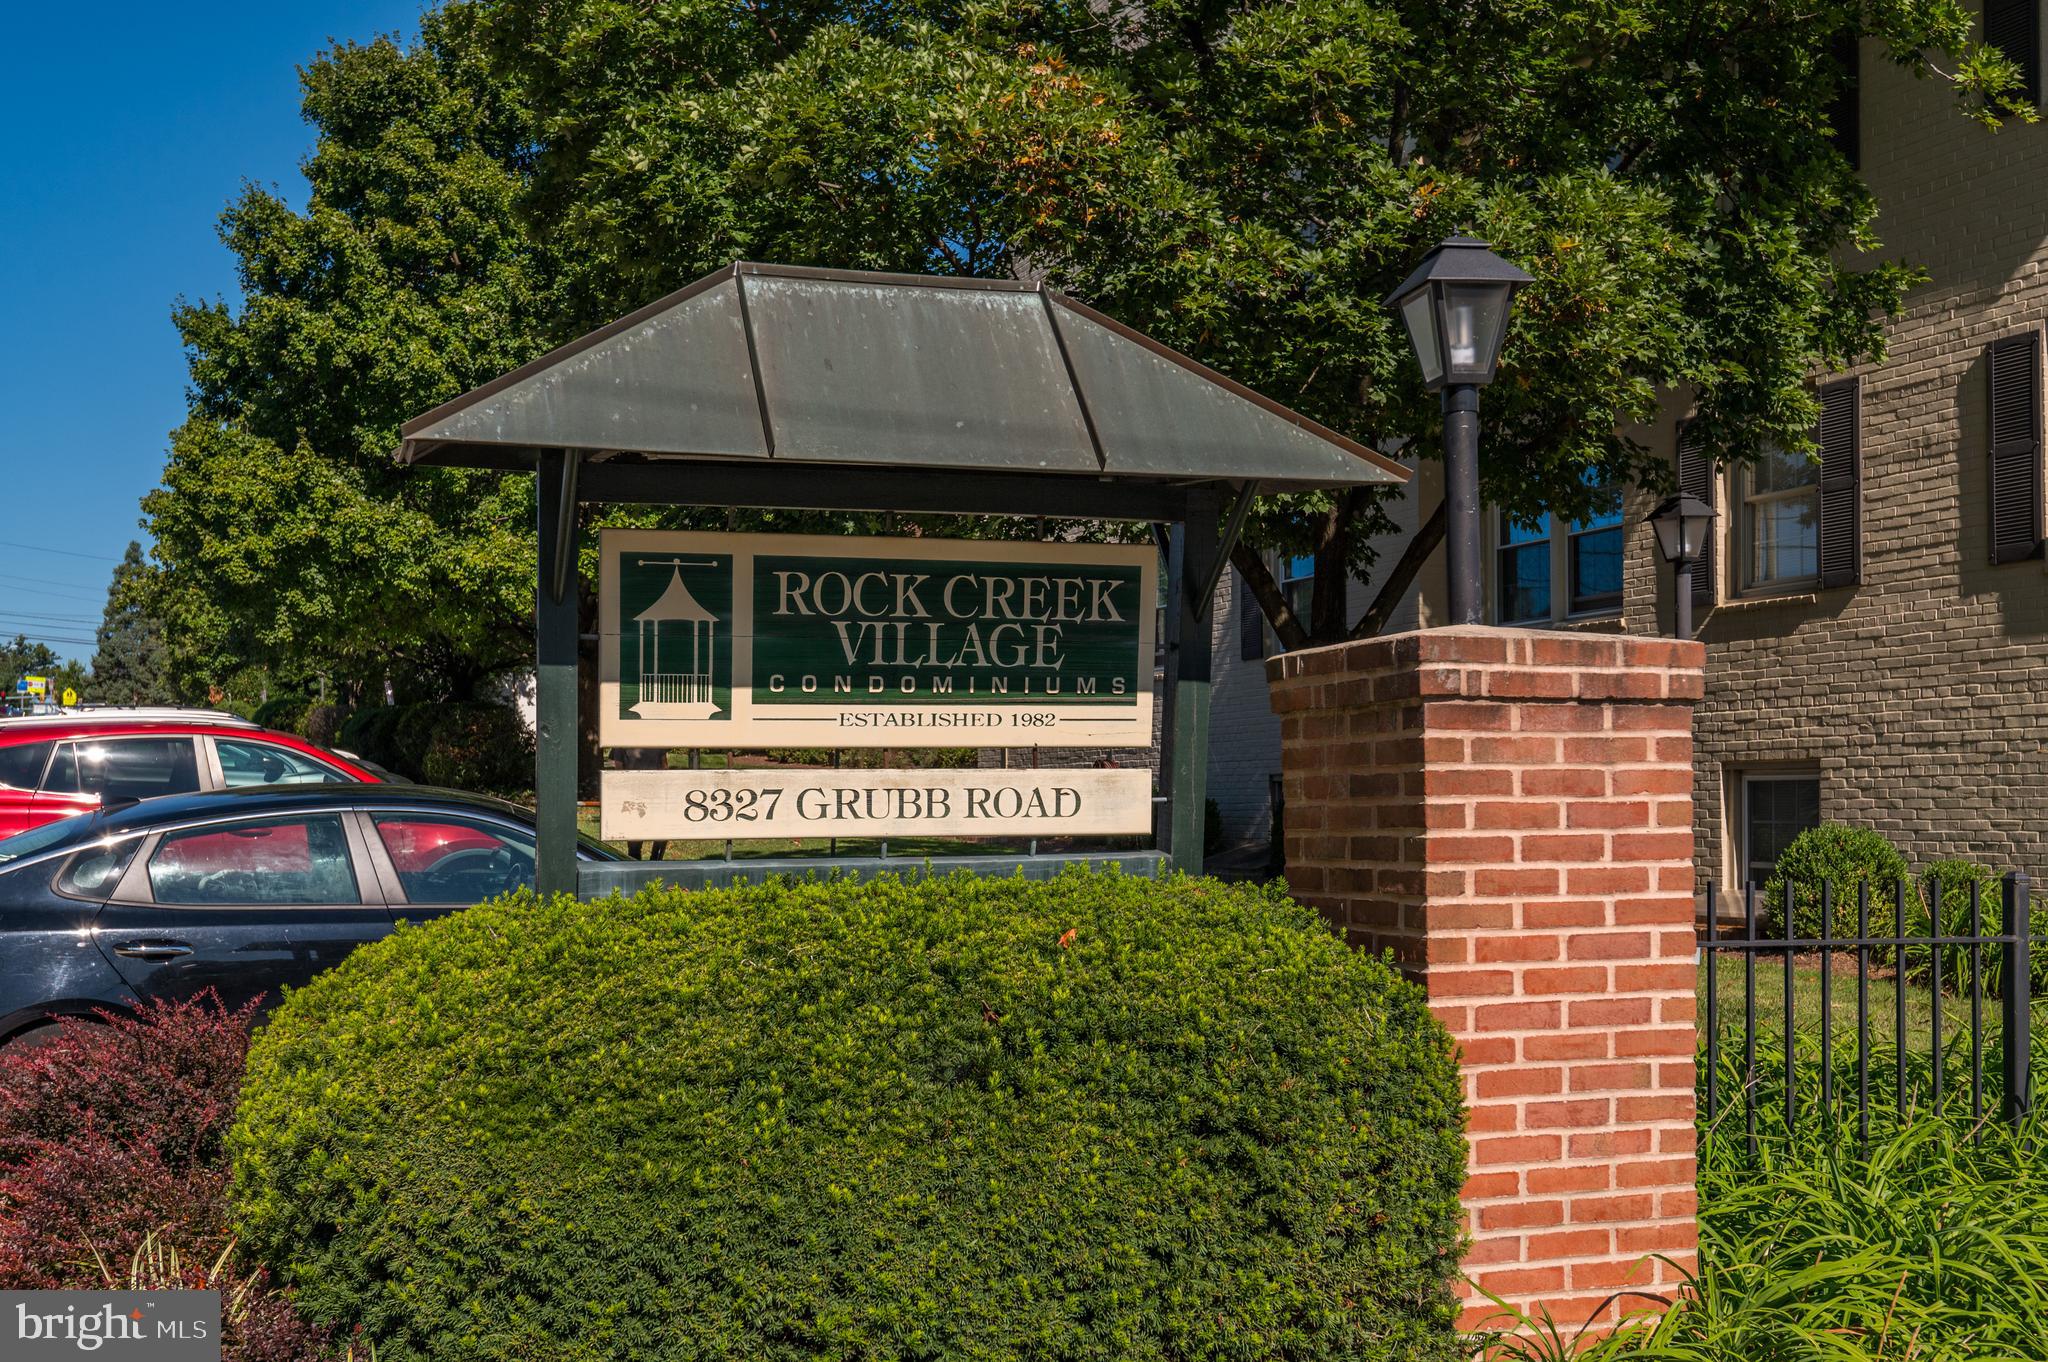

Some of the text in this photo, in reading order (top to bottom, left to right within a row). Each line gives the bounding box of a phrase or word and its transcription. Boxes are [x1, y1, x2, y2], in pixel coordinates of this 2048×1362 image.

[772, 570, 1126, 624] ROCK CREEK
[830, 620, 1066, 671] VILLAGE
[769, 673, 1127, 695] CONDOMINIUMS
[838, 711, 1056, 728] ESTABLISHED 1982
[683, 786, 1083, 823] 8327 GRUBB ROAD
